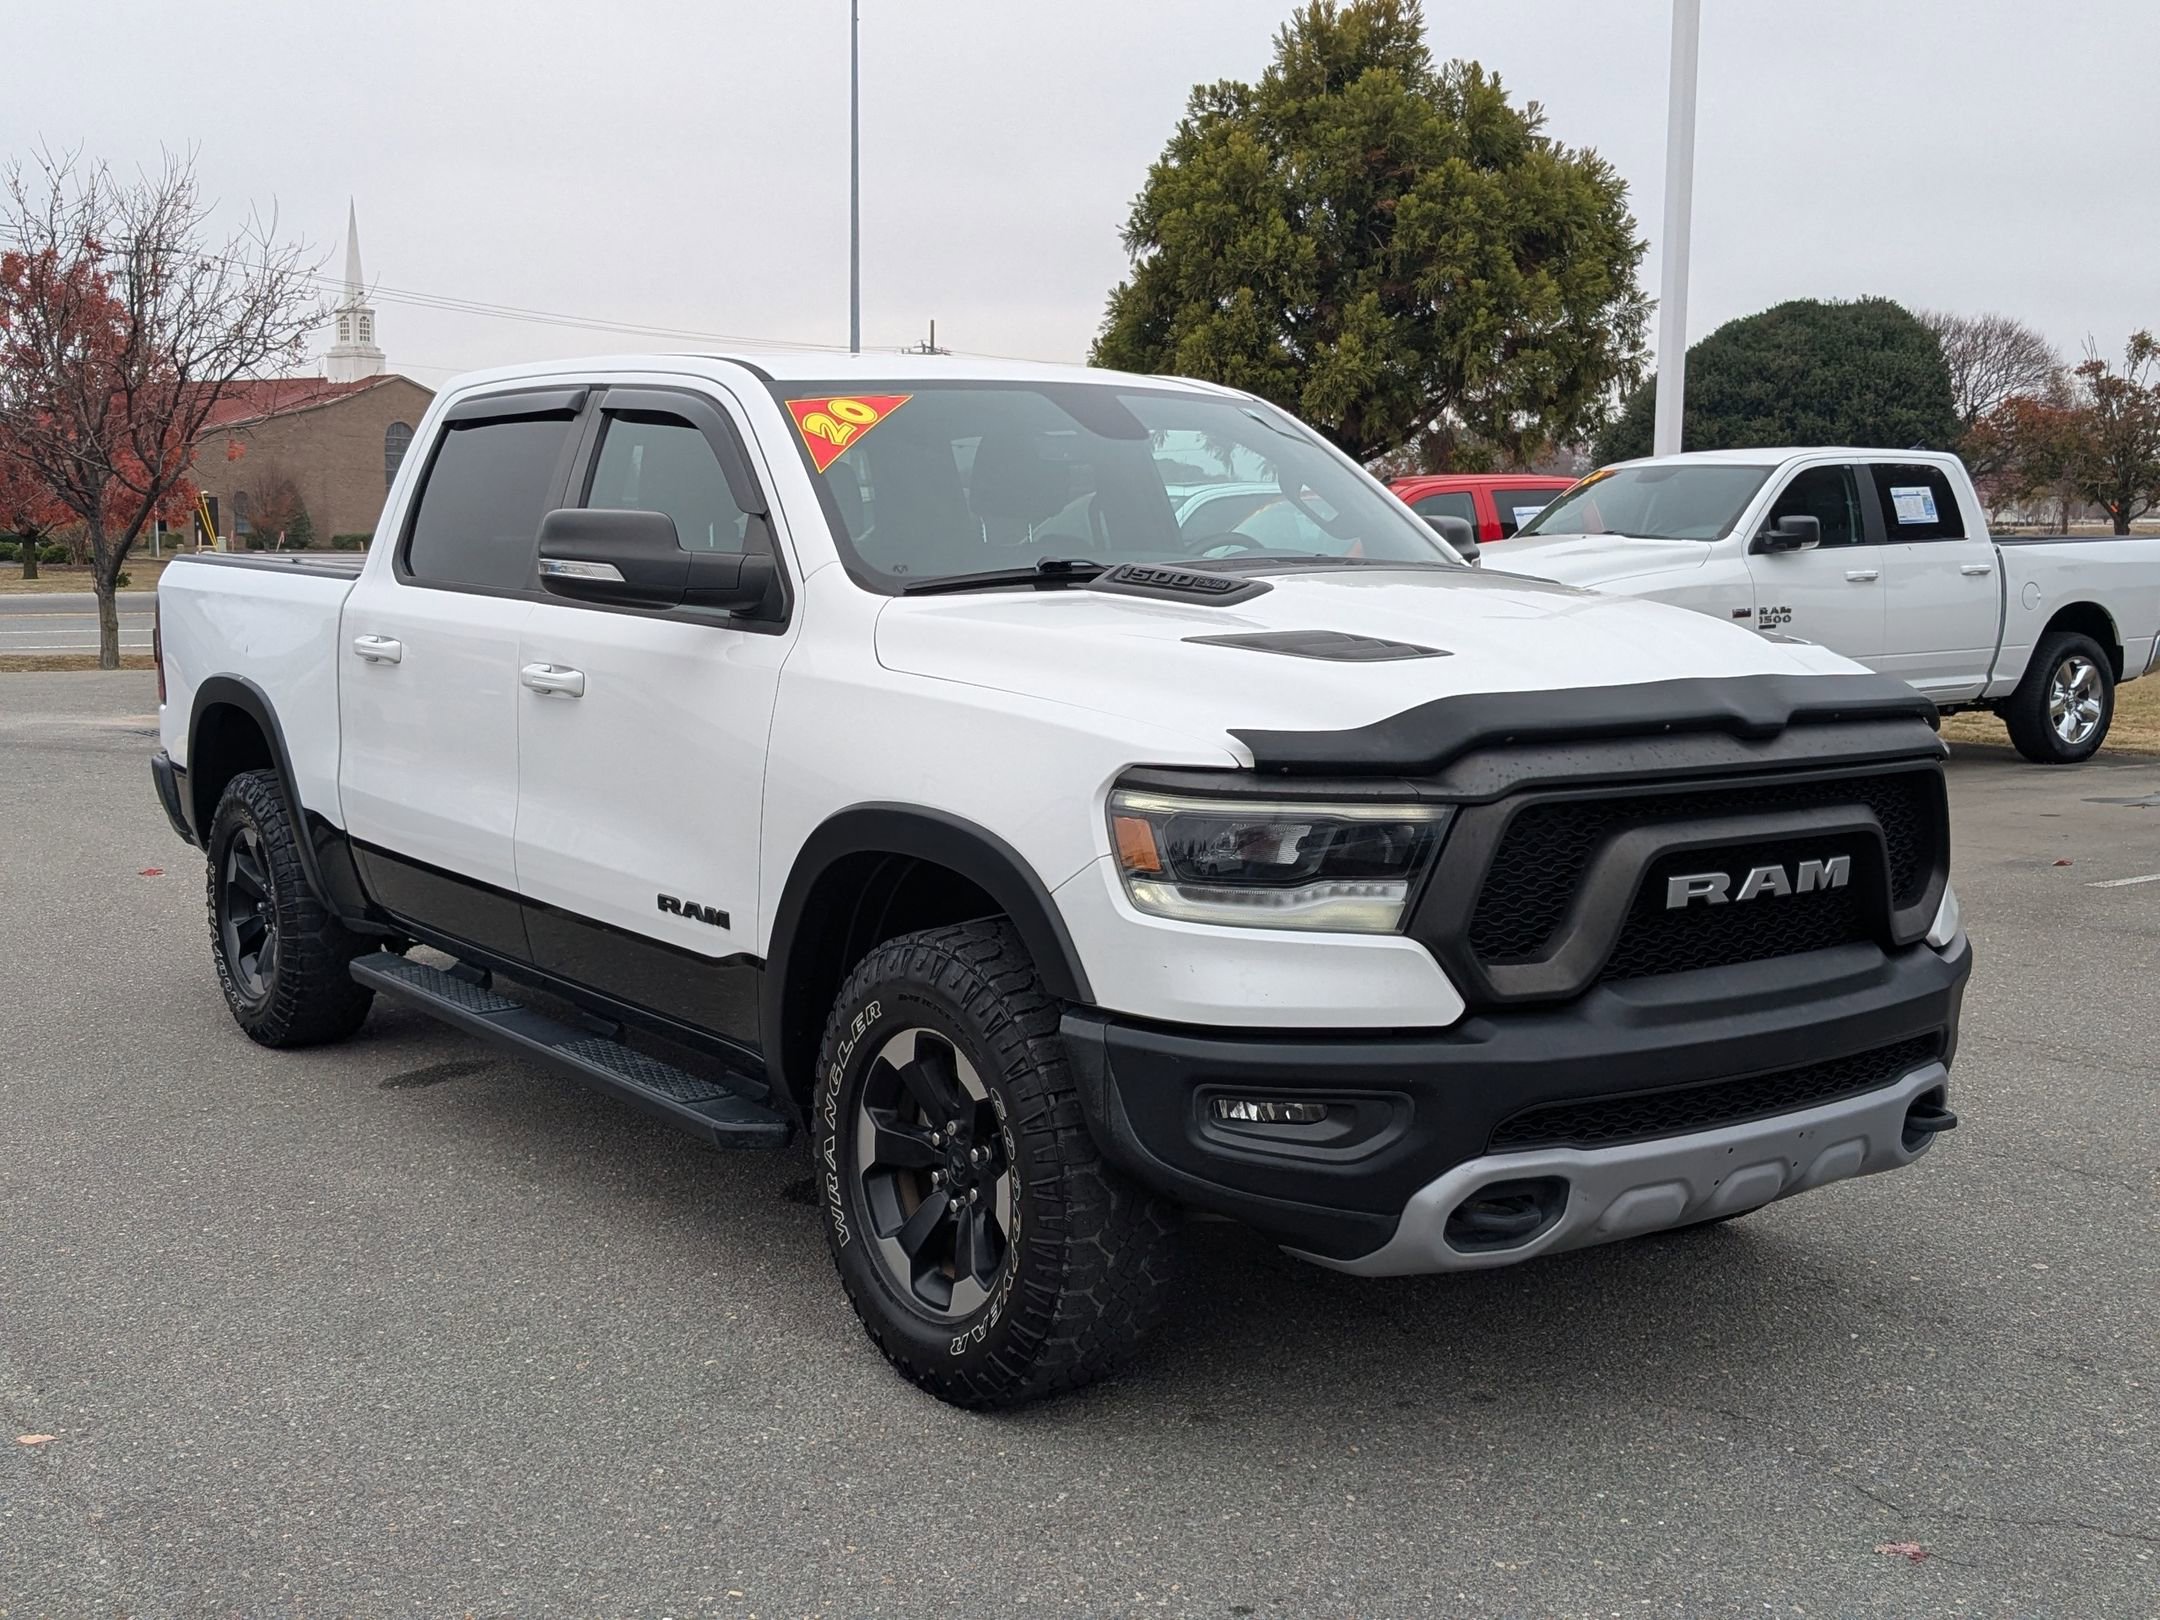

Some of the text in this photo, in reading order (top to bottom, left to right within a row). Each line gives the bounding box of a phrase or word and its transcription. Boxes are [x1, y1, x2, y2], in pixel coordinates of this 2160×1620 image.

[803, 399, 878, 446] 20
[1119, 566, 1196, 587] 1500
[1759, 606, 1792, 615] RAM
[1759, 614, 1792, 624] 1500
[1666, 855, 1850, 909] RAM
[657, 893, 731, 931] RAM
[823, 1000, 883, 1247] WRANGLER
[949, 1087, 1021, 1356] GOODYEAR
